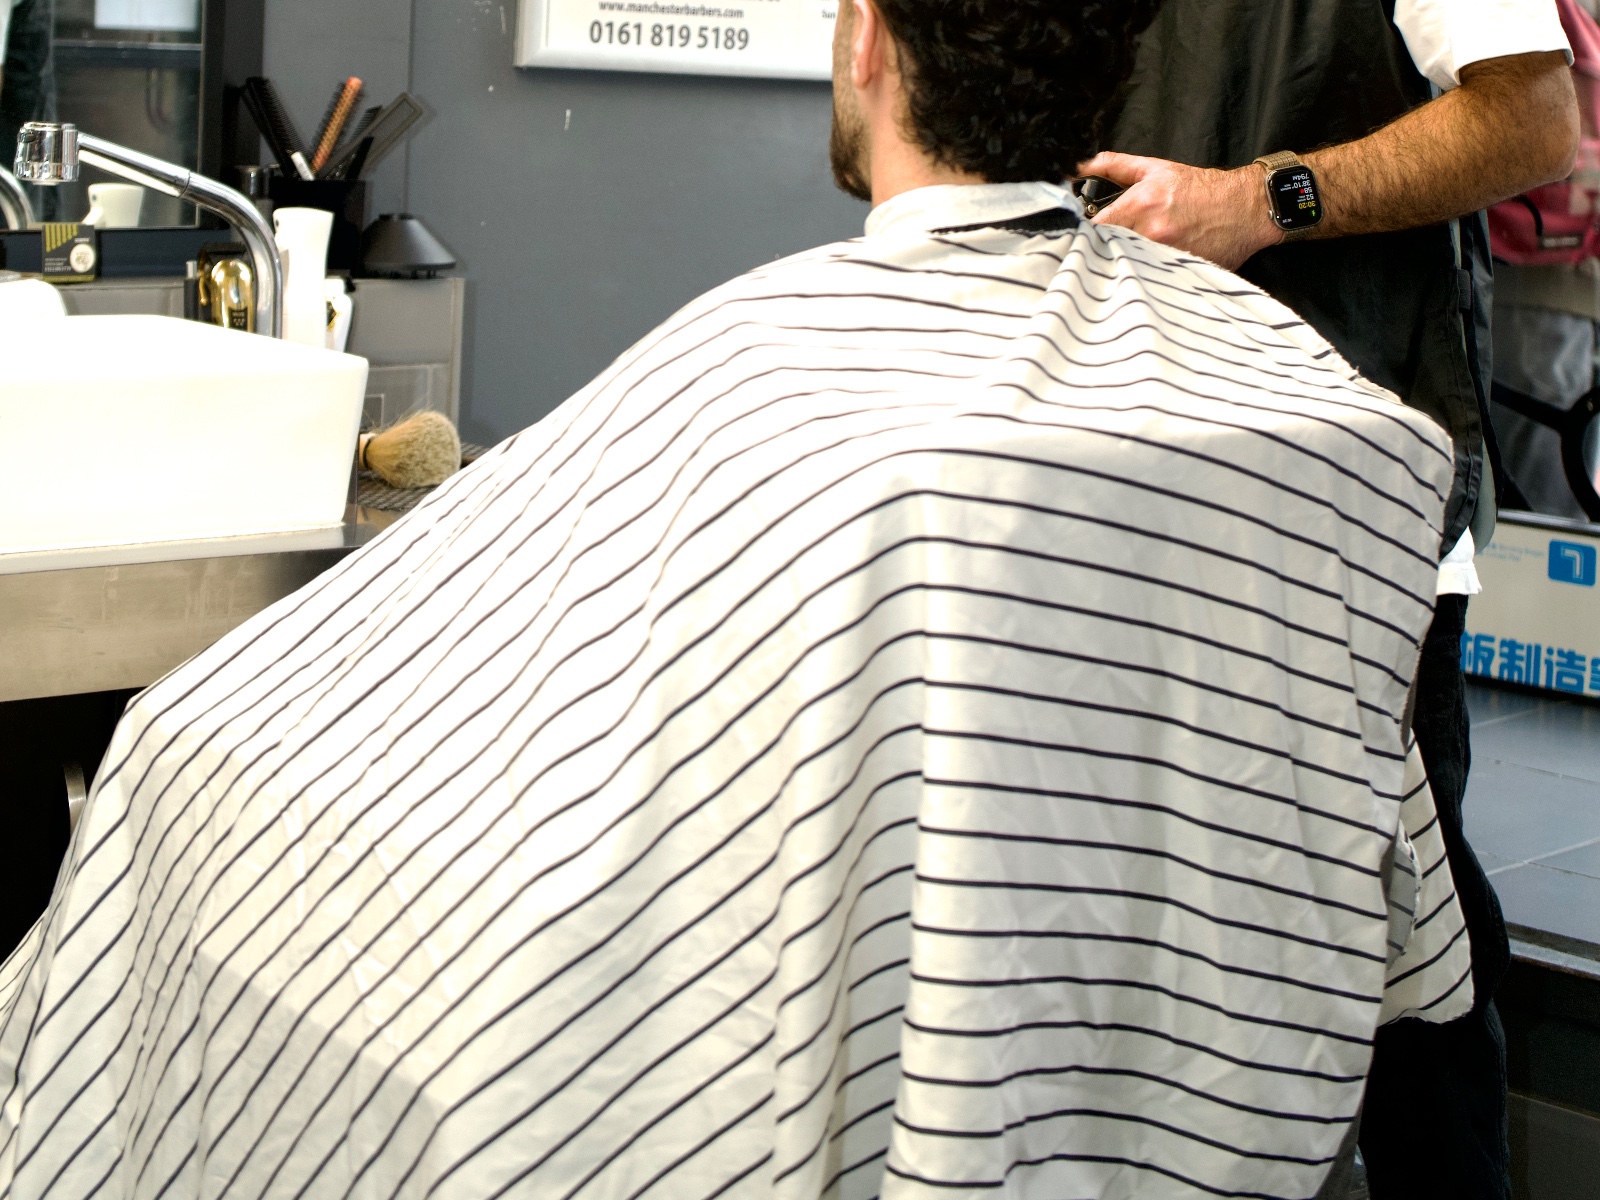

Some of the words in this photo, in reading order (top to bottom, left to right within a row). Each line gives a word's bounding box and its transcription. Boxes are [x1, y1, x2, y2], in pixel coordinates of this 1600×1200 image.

[598, 0, 744, 18] www.manchesterbarbers.com
[589, 20, 643, 45] 0161
[650, 23, 691, 48] 819
[697, 26, 749, 50] 5189
